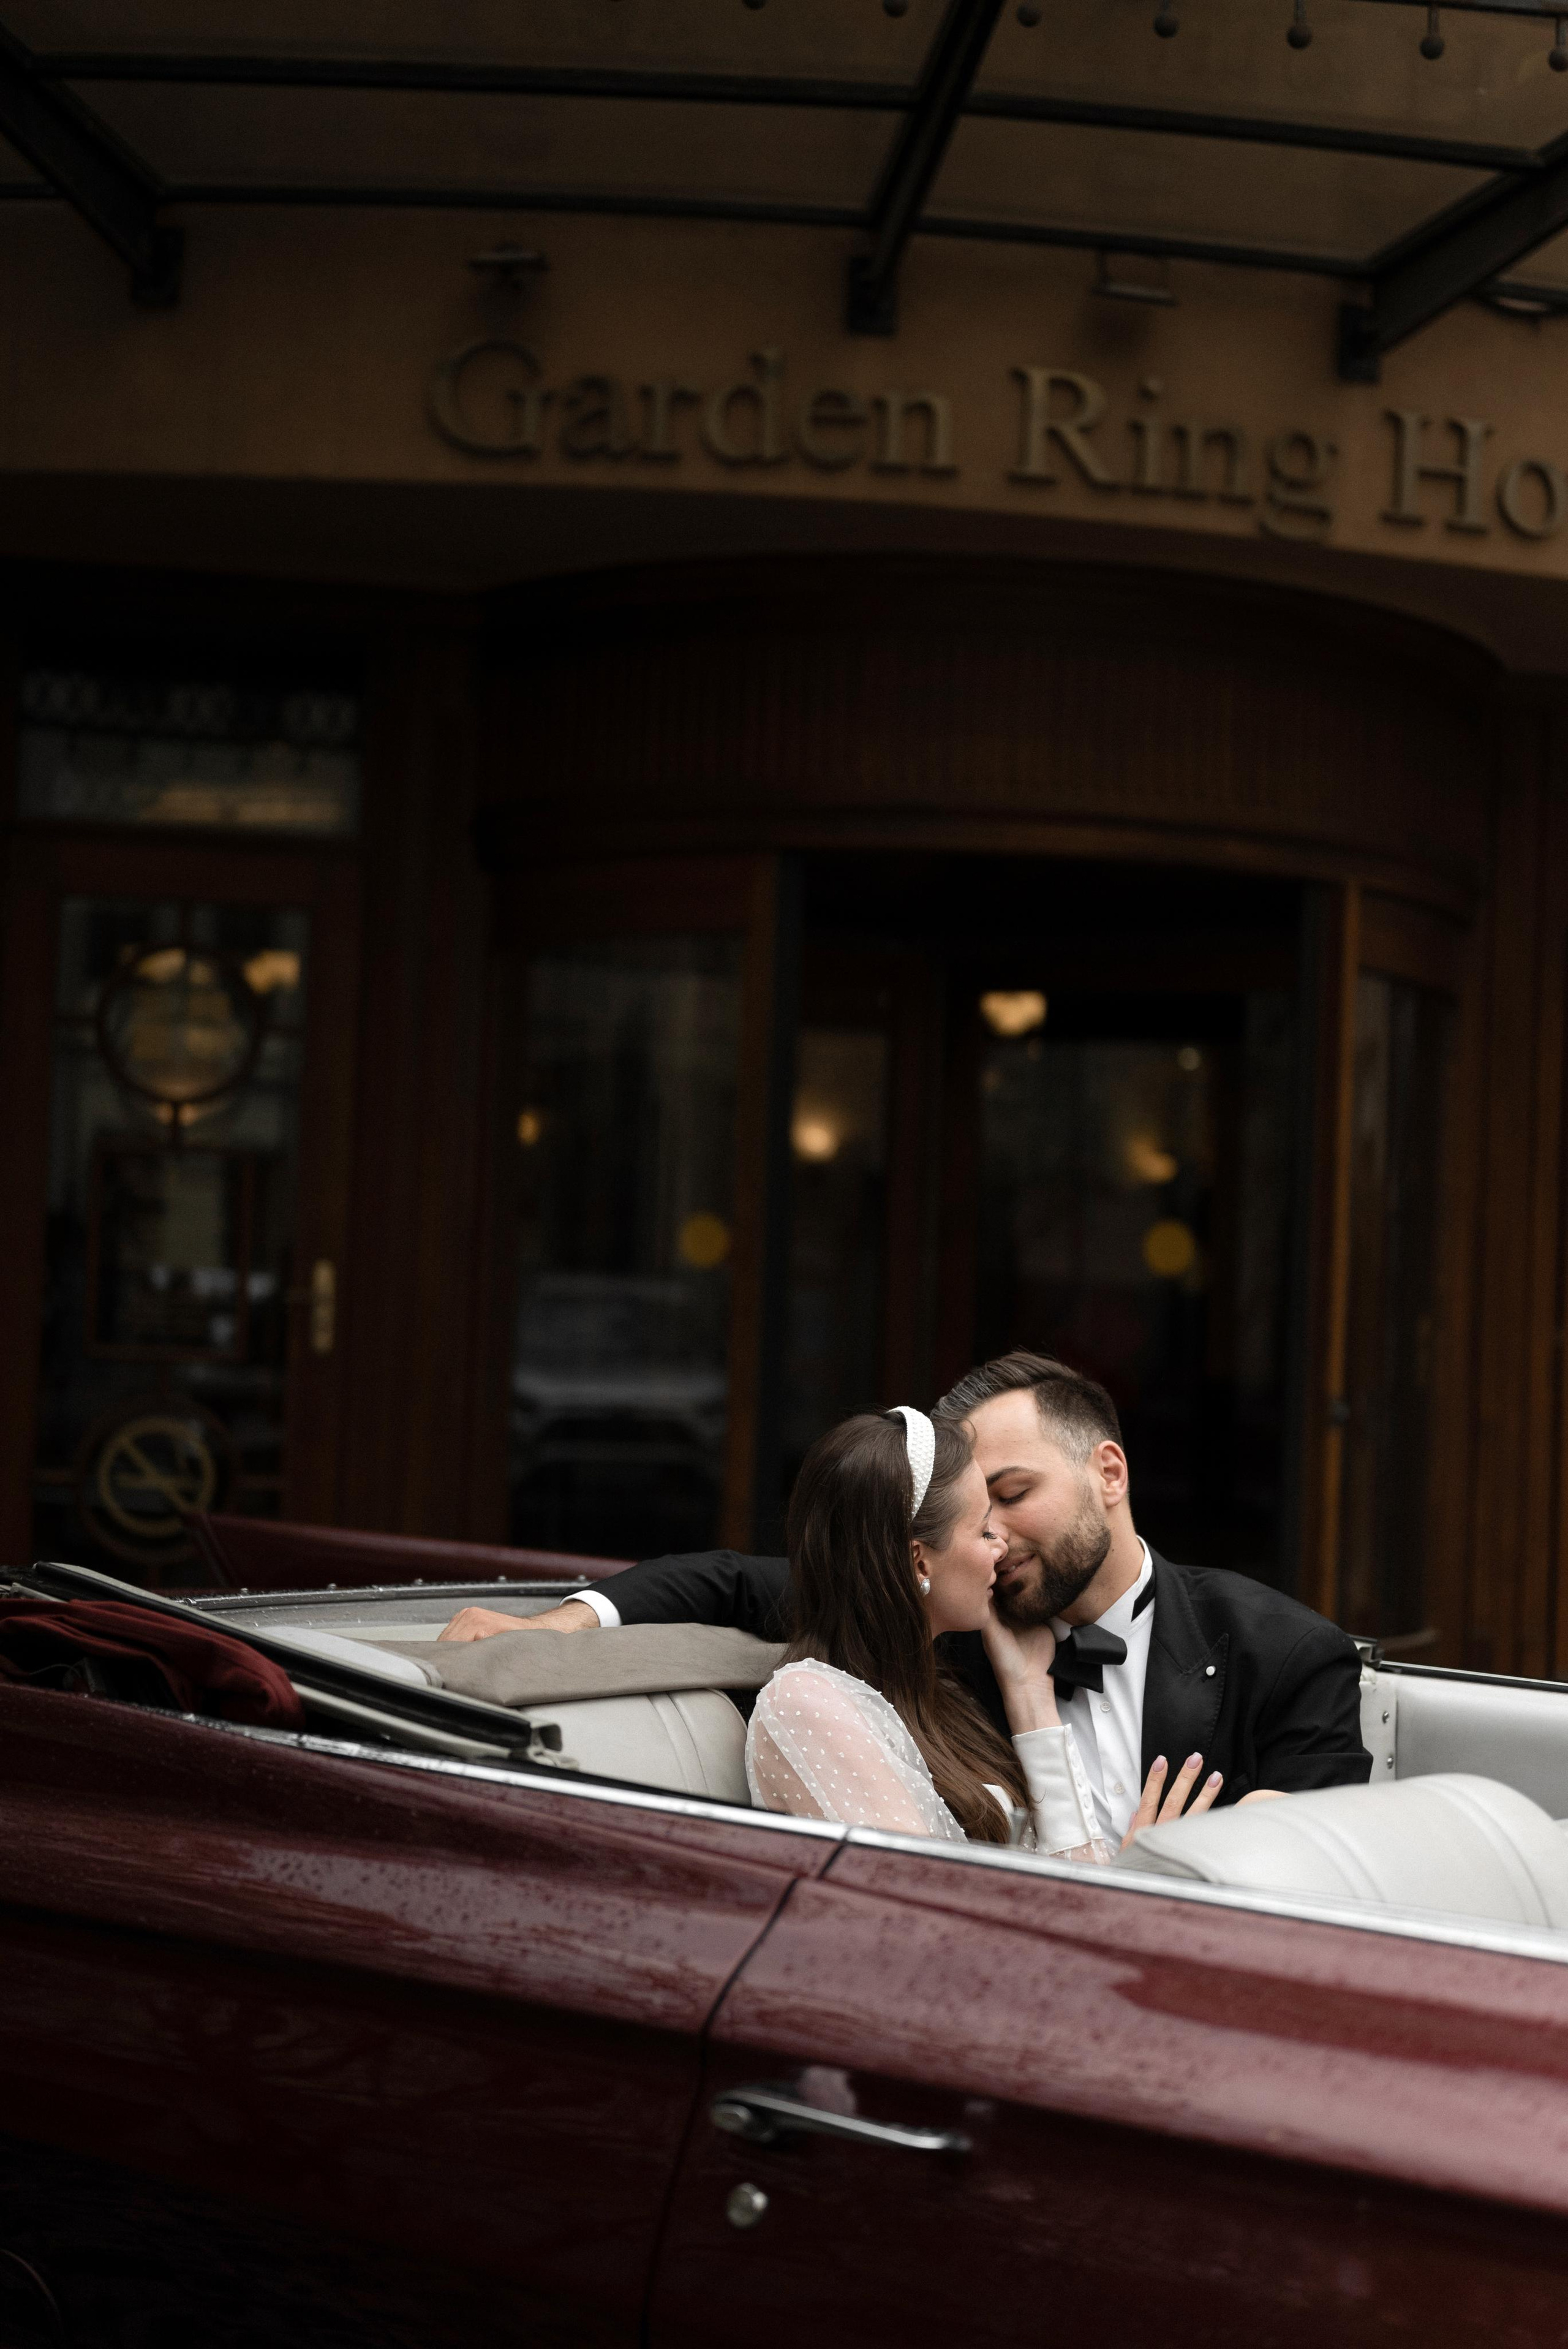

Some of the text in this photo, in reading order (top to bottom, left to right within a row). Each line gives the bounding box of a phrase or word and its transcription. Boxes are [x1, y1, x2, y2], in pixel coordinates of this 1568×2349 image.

[425, 338, 1568, 542] Garden Ring Ho
